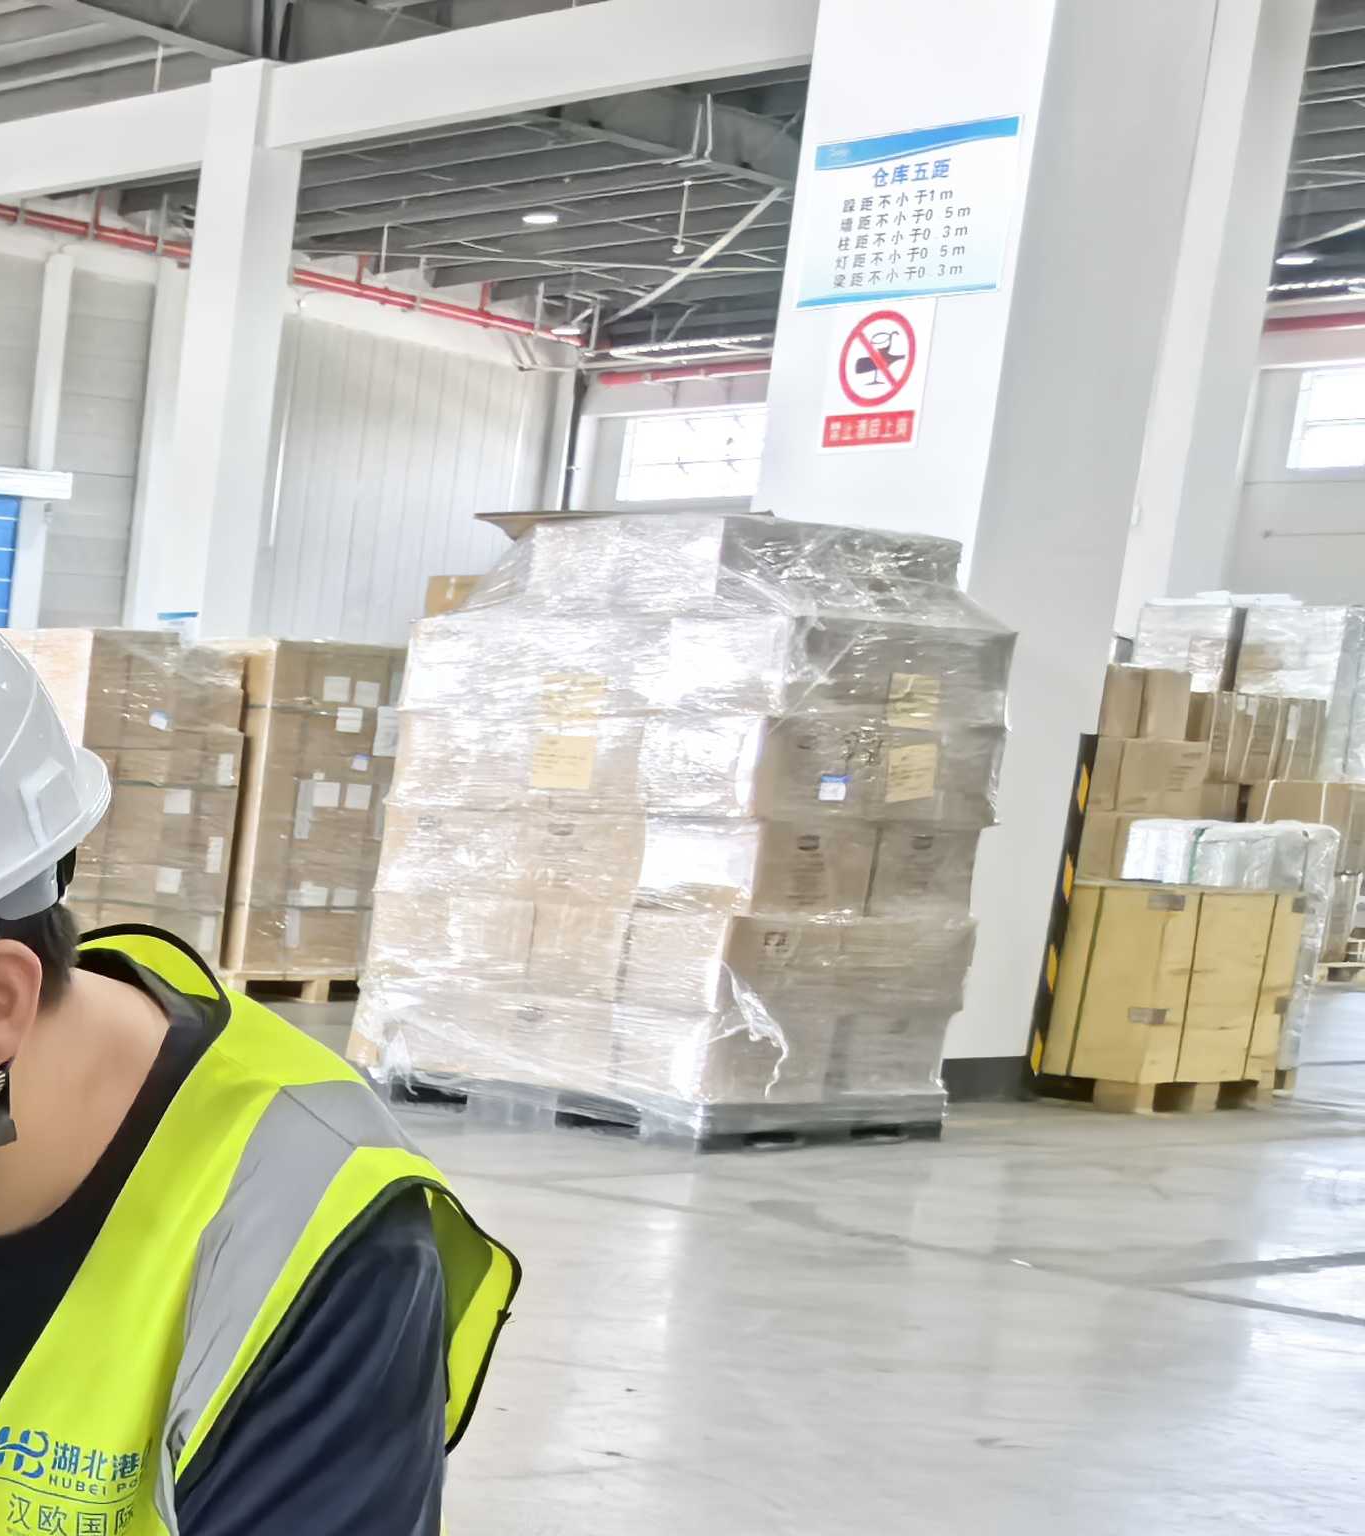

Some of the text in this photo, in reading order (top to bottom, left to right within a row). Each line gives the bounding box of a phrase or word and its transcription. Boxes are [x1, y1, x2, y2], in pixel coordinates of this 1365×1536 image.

[871, 157, 953, 189] 仓库五距
[51, 1441, 140, 1482] 湖北港
[48, 1474, 107, 1497] HUBEI
